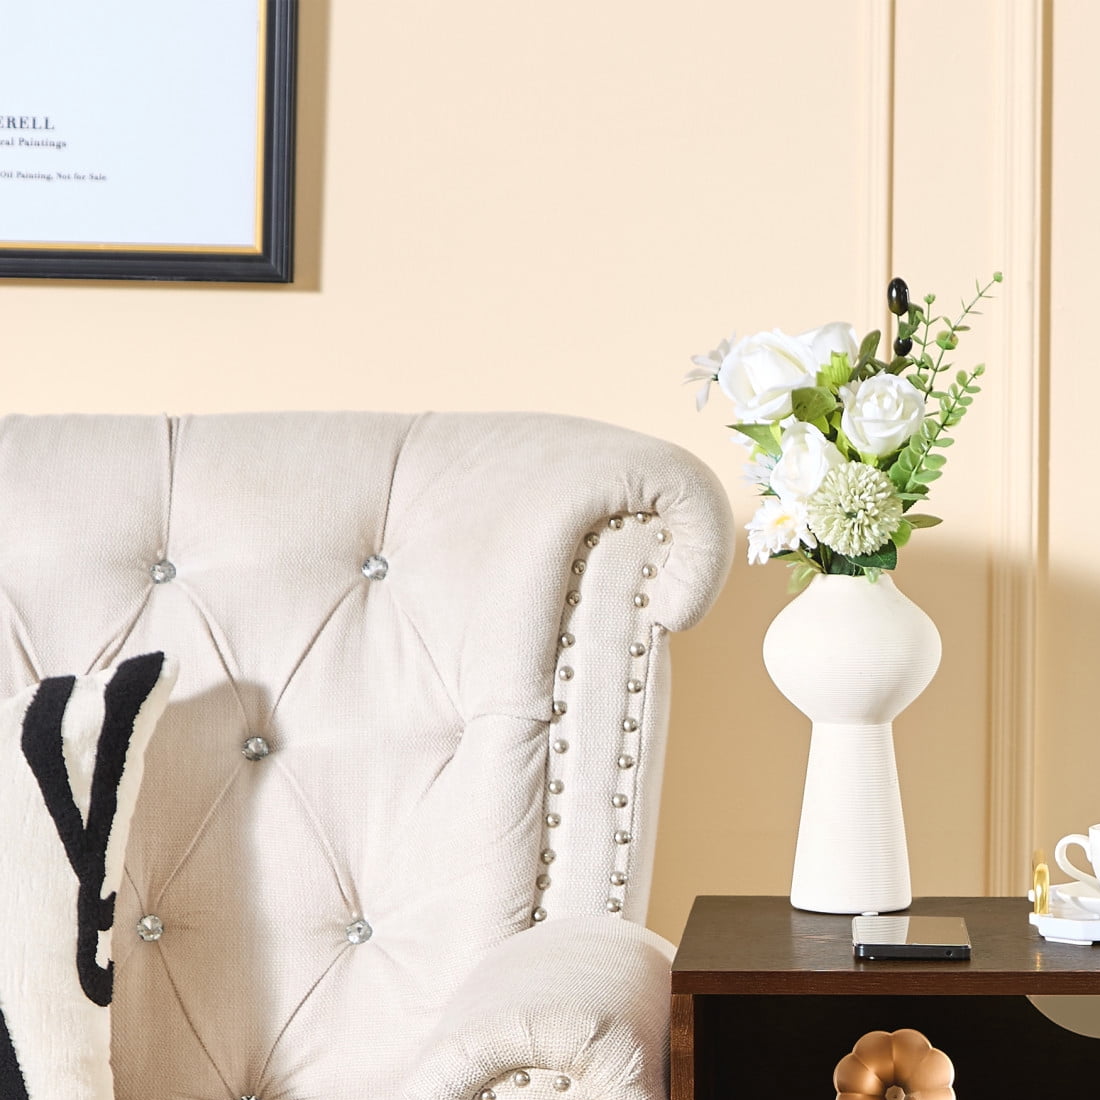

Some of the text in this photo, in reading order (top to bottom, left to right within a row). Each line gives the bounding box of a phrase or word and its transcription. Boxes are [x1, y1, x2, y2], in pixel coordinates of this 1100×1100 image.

[18, 137, 67, 149] Paintings
[56, 172, 71, 180] Not
[73, 172, 86, 180] for
[89, 173, 107, 181] Sale
